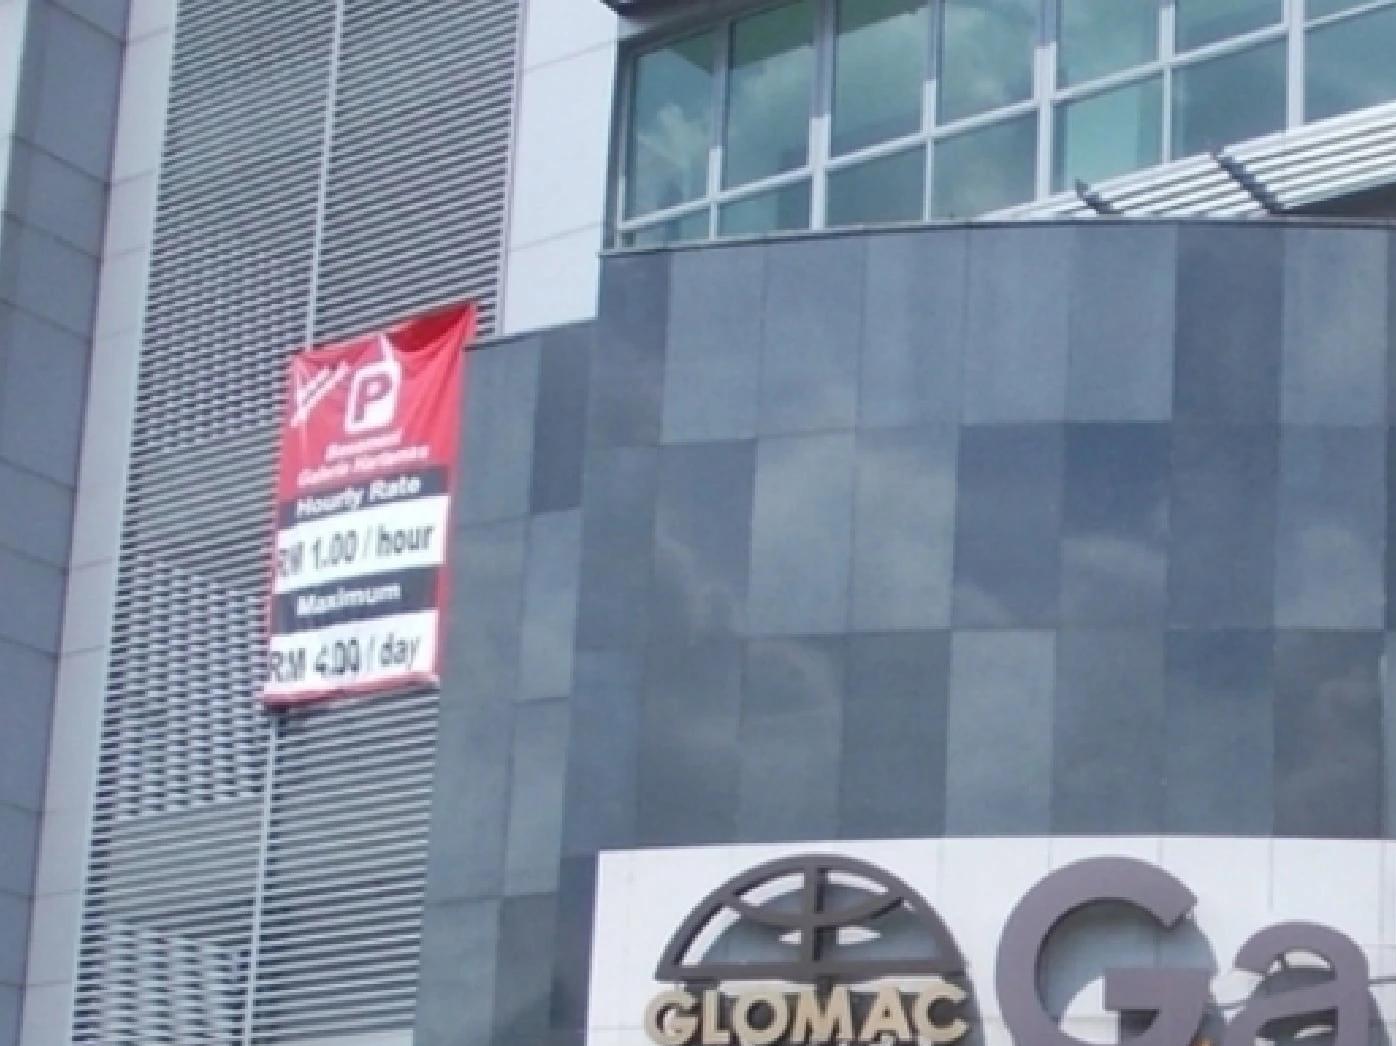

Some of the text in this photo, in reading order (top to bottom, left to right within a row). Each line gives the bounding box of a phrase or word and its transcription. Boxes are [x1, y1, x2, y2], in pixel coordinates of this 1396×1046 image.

[297, 475, 422, 516] Hourly Rate
[375, 523, 436, 558] hour
[380, 632, 422, 671] day
